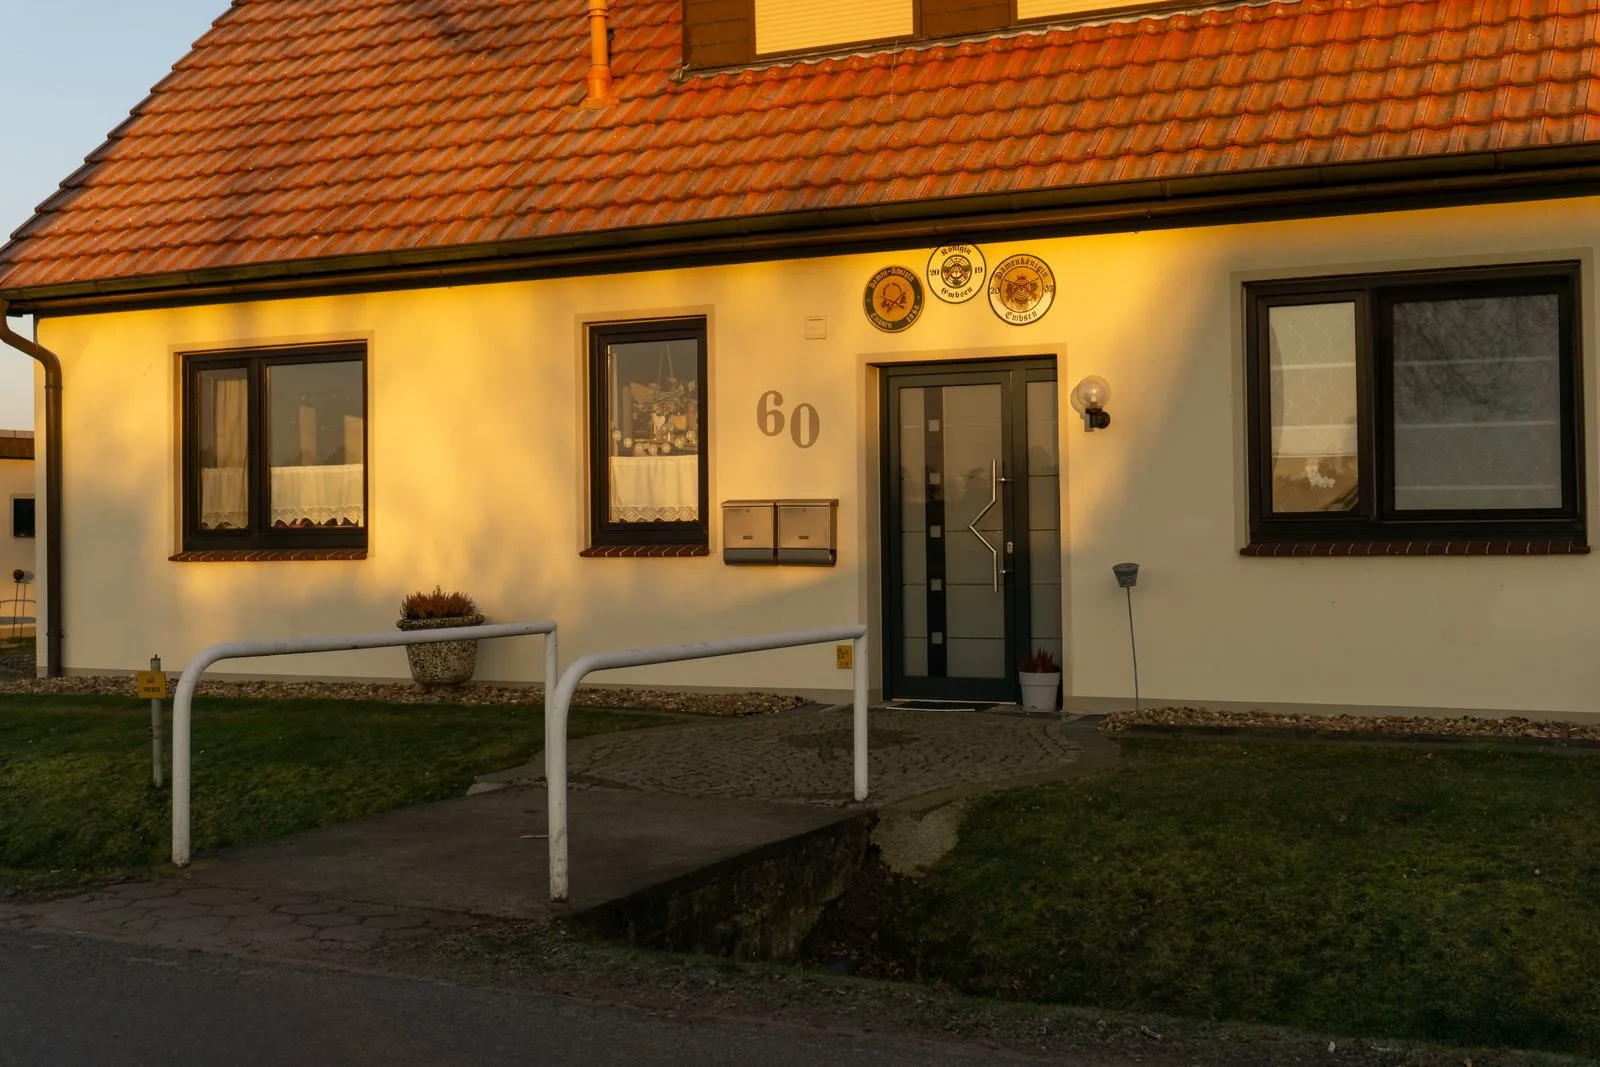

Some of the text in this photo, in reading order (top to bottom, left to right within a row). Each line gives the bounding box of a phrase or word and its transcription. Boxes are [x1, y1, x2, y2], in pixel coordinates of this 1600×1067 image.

[930, 266, 983, 276] 20 19
[941, 287, 973, 299] Embsen
[990, 286, 1000, 295] 20
[1005, 310, 1038, 322] Embsen
[756, 390, 820, 449] 60
